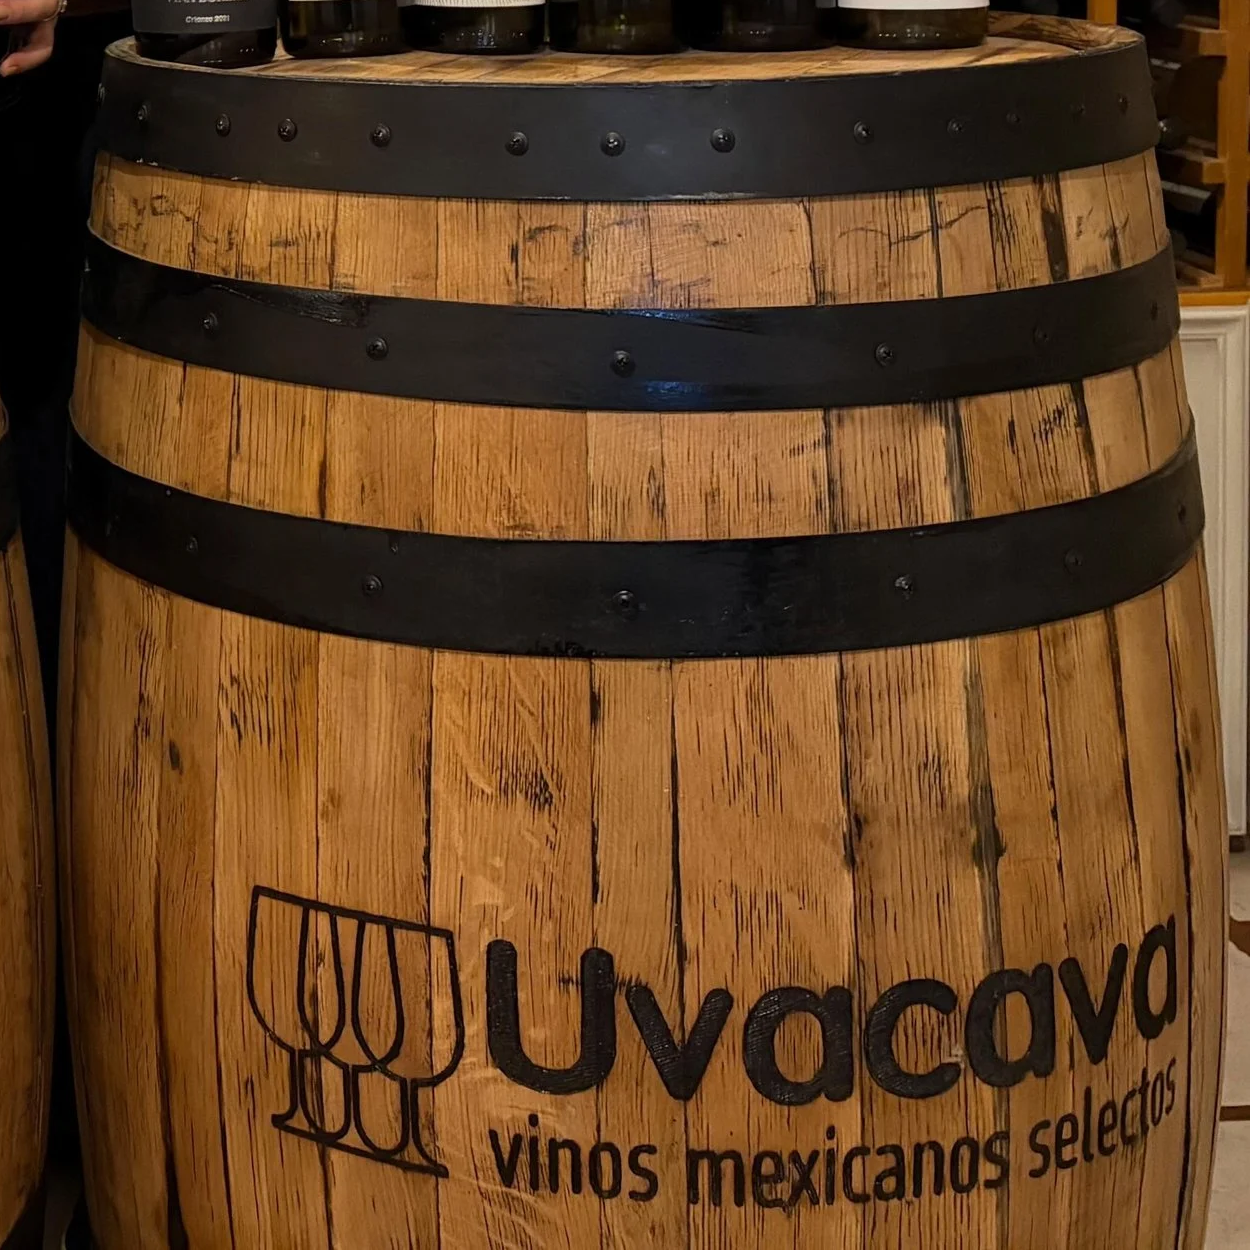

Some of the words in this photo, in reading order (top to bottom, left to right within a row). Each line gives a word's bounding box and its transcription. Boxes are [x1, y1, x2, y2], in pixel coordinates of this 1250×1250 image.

[485, 914, 1178, 1107] Uvacava
[488, 1113, 659, 1202] vinos
[687, 1125, 1010, 1209] mexicanos
[1029, 1057, 1178, 1180] selectos
